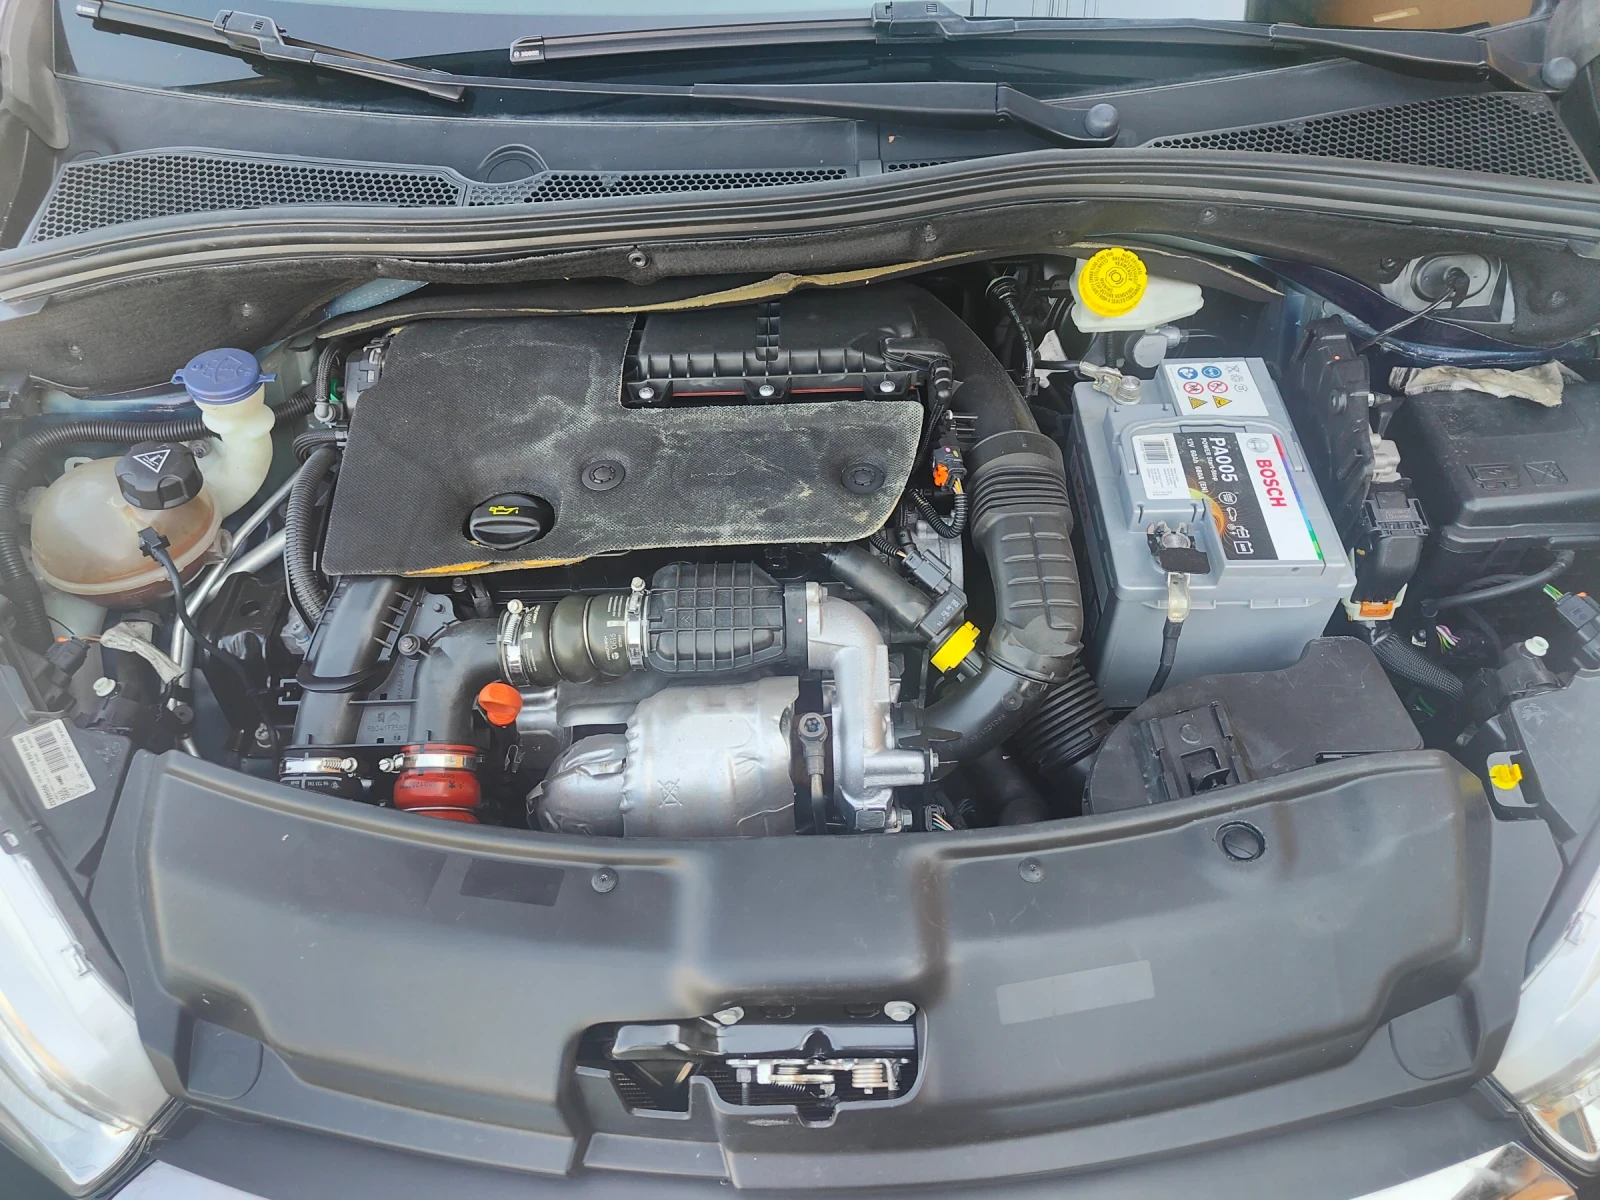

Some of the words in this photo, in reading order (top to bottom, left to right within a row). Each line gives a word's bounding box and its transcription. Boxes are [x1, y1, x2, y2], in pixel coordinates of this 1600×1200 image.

[1187, 438, 1195, 447] 12V
[1201, 438, 1211, 455] POWER
[1209, 437, 1238, 482] PA005
[1256, 460, 1287, 506] BOSCH
